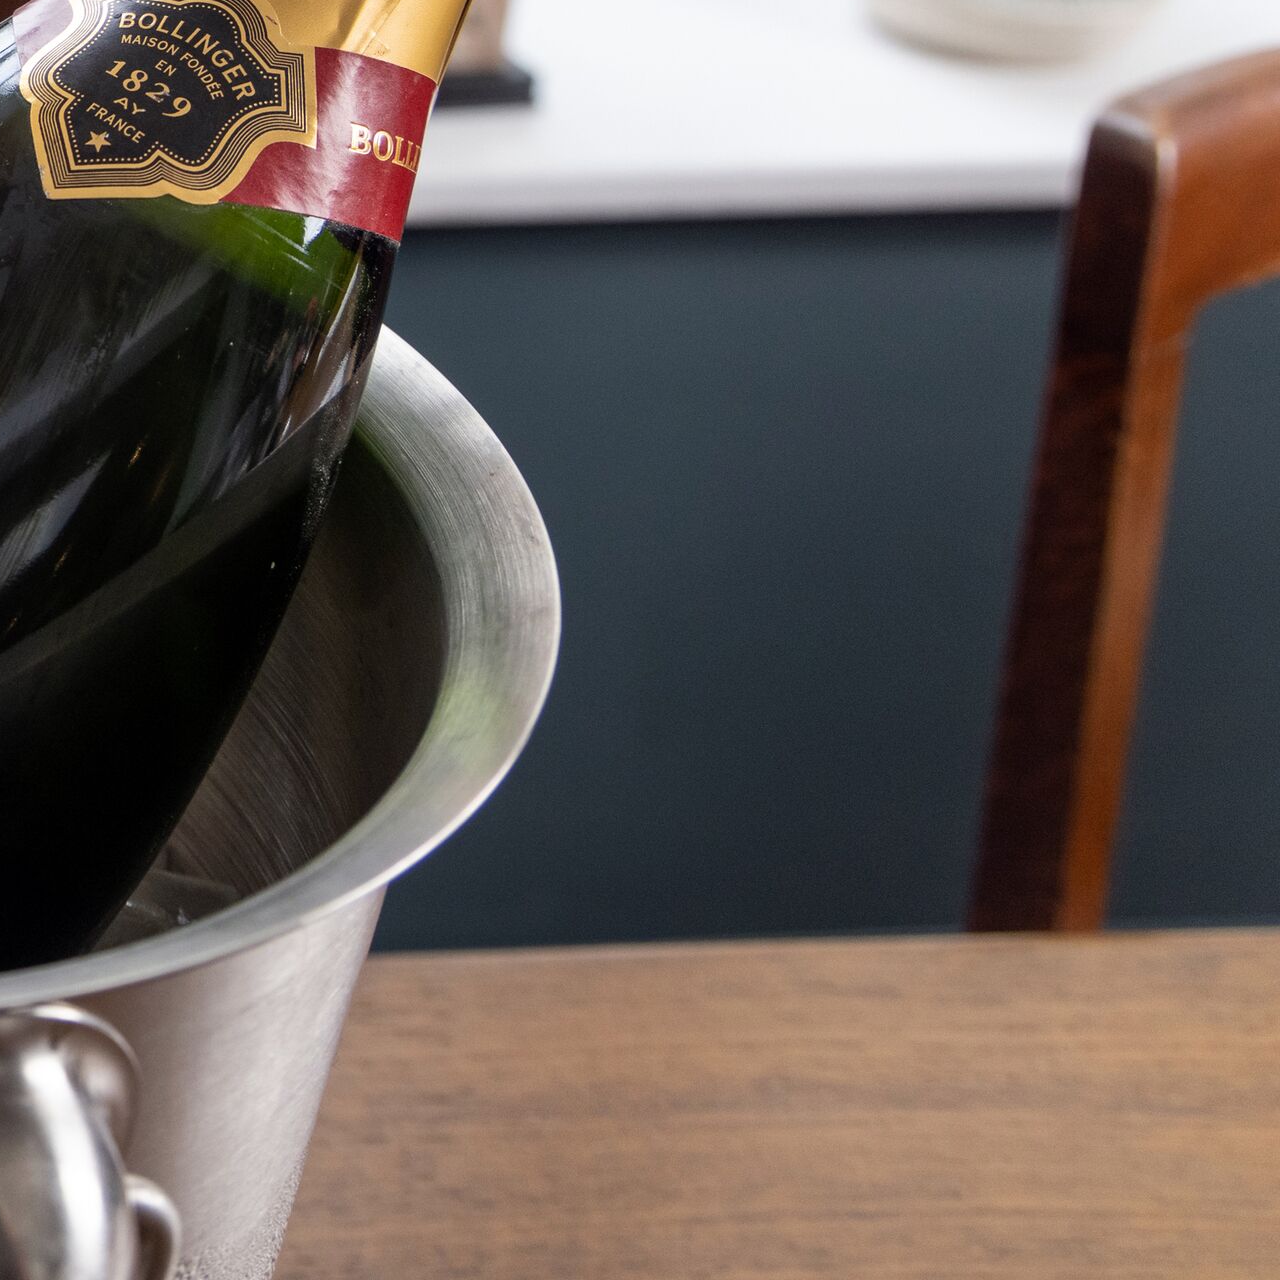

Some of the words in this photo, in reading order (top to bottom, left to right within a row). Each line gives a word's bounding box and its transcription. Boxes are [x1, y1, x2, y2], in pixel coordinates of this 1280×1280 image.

[118, 12, 257, 101] BOLLINGER
[120, 34, 180, 56] MAISON
[179, 52, 225, 100] FONDÉE
[154, 59, 177, 77] EN
[105, 60, 192, 118] 1829
[113, 97, 147, 116] AY
[86, 102, 146, 144] FRANCE
